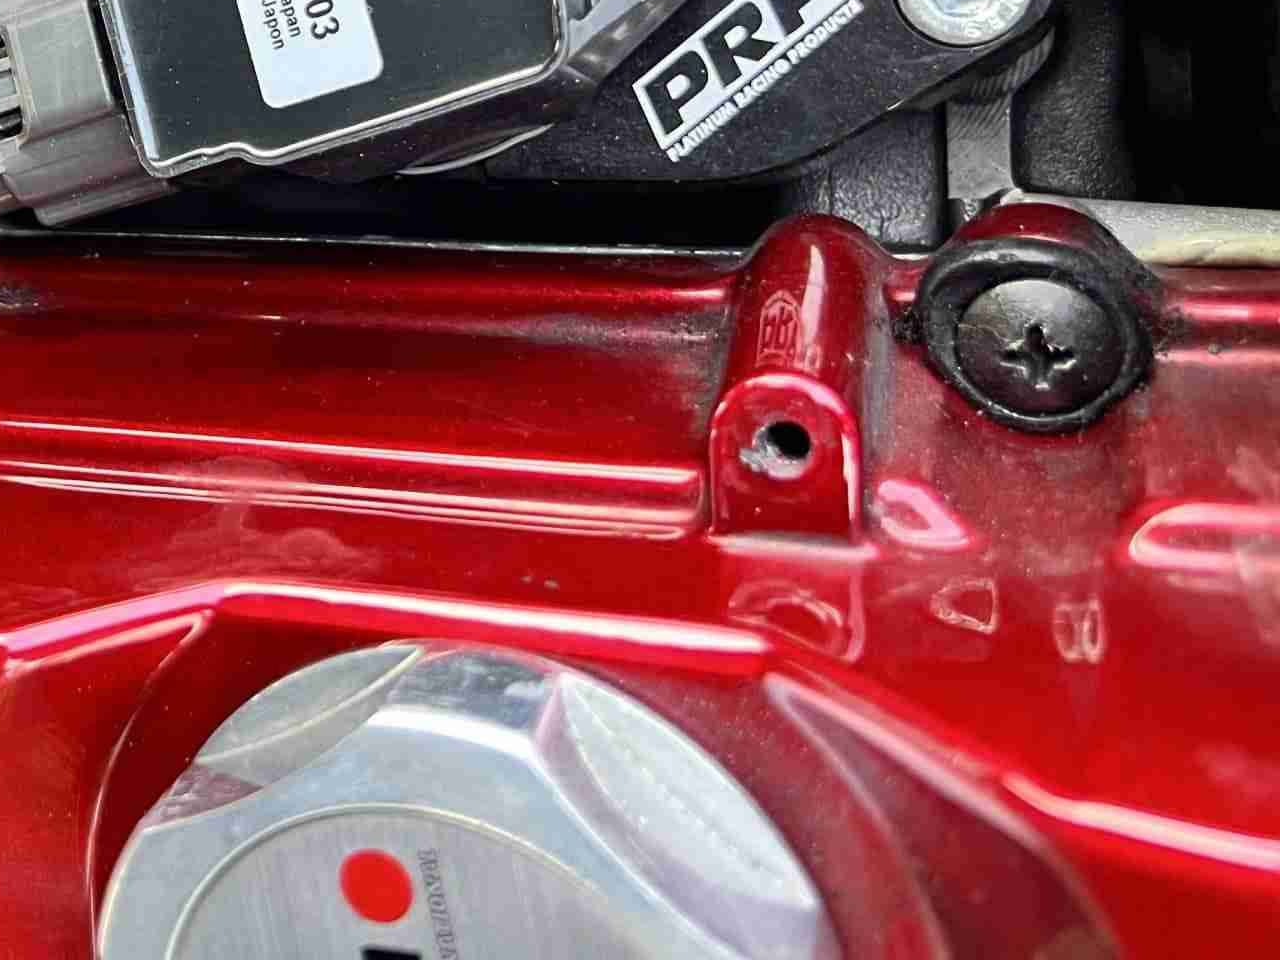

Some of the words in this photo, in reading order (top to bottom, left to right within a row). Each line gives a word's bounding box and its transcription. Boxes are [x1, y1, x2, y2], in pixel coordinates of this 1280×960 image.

[261, 0, 285, 50] Japon
[666, 100, 739, 162] PLATINUM
[732, 58, 793, 108] RACING
